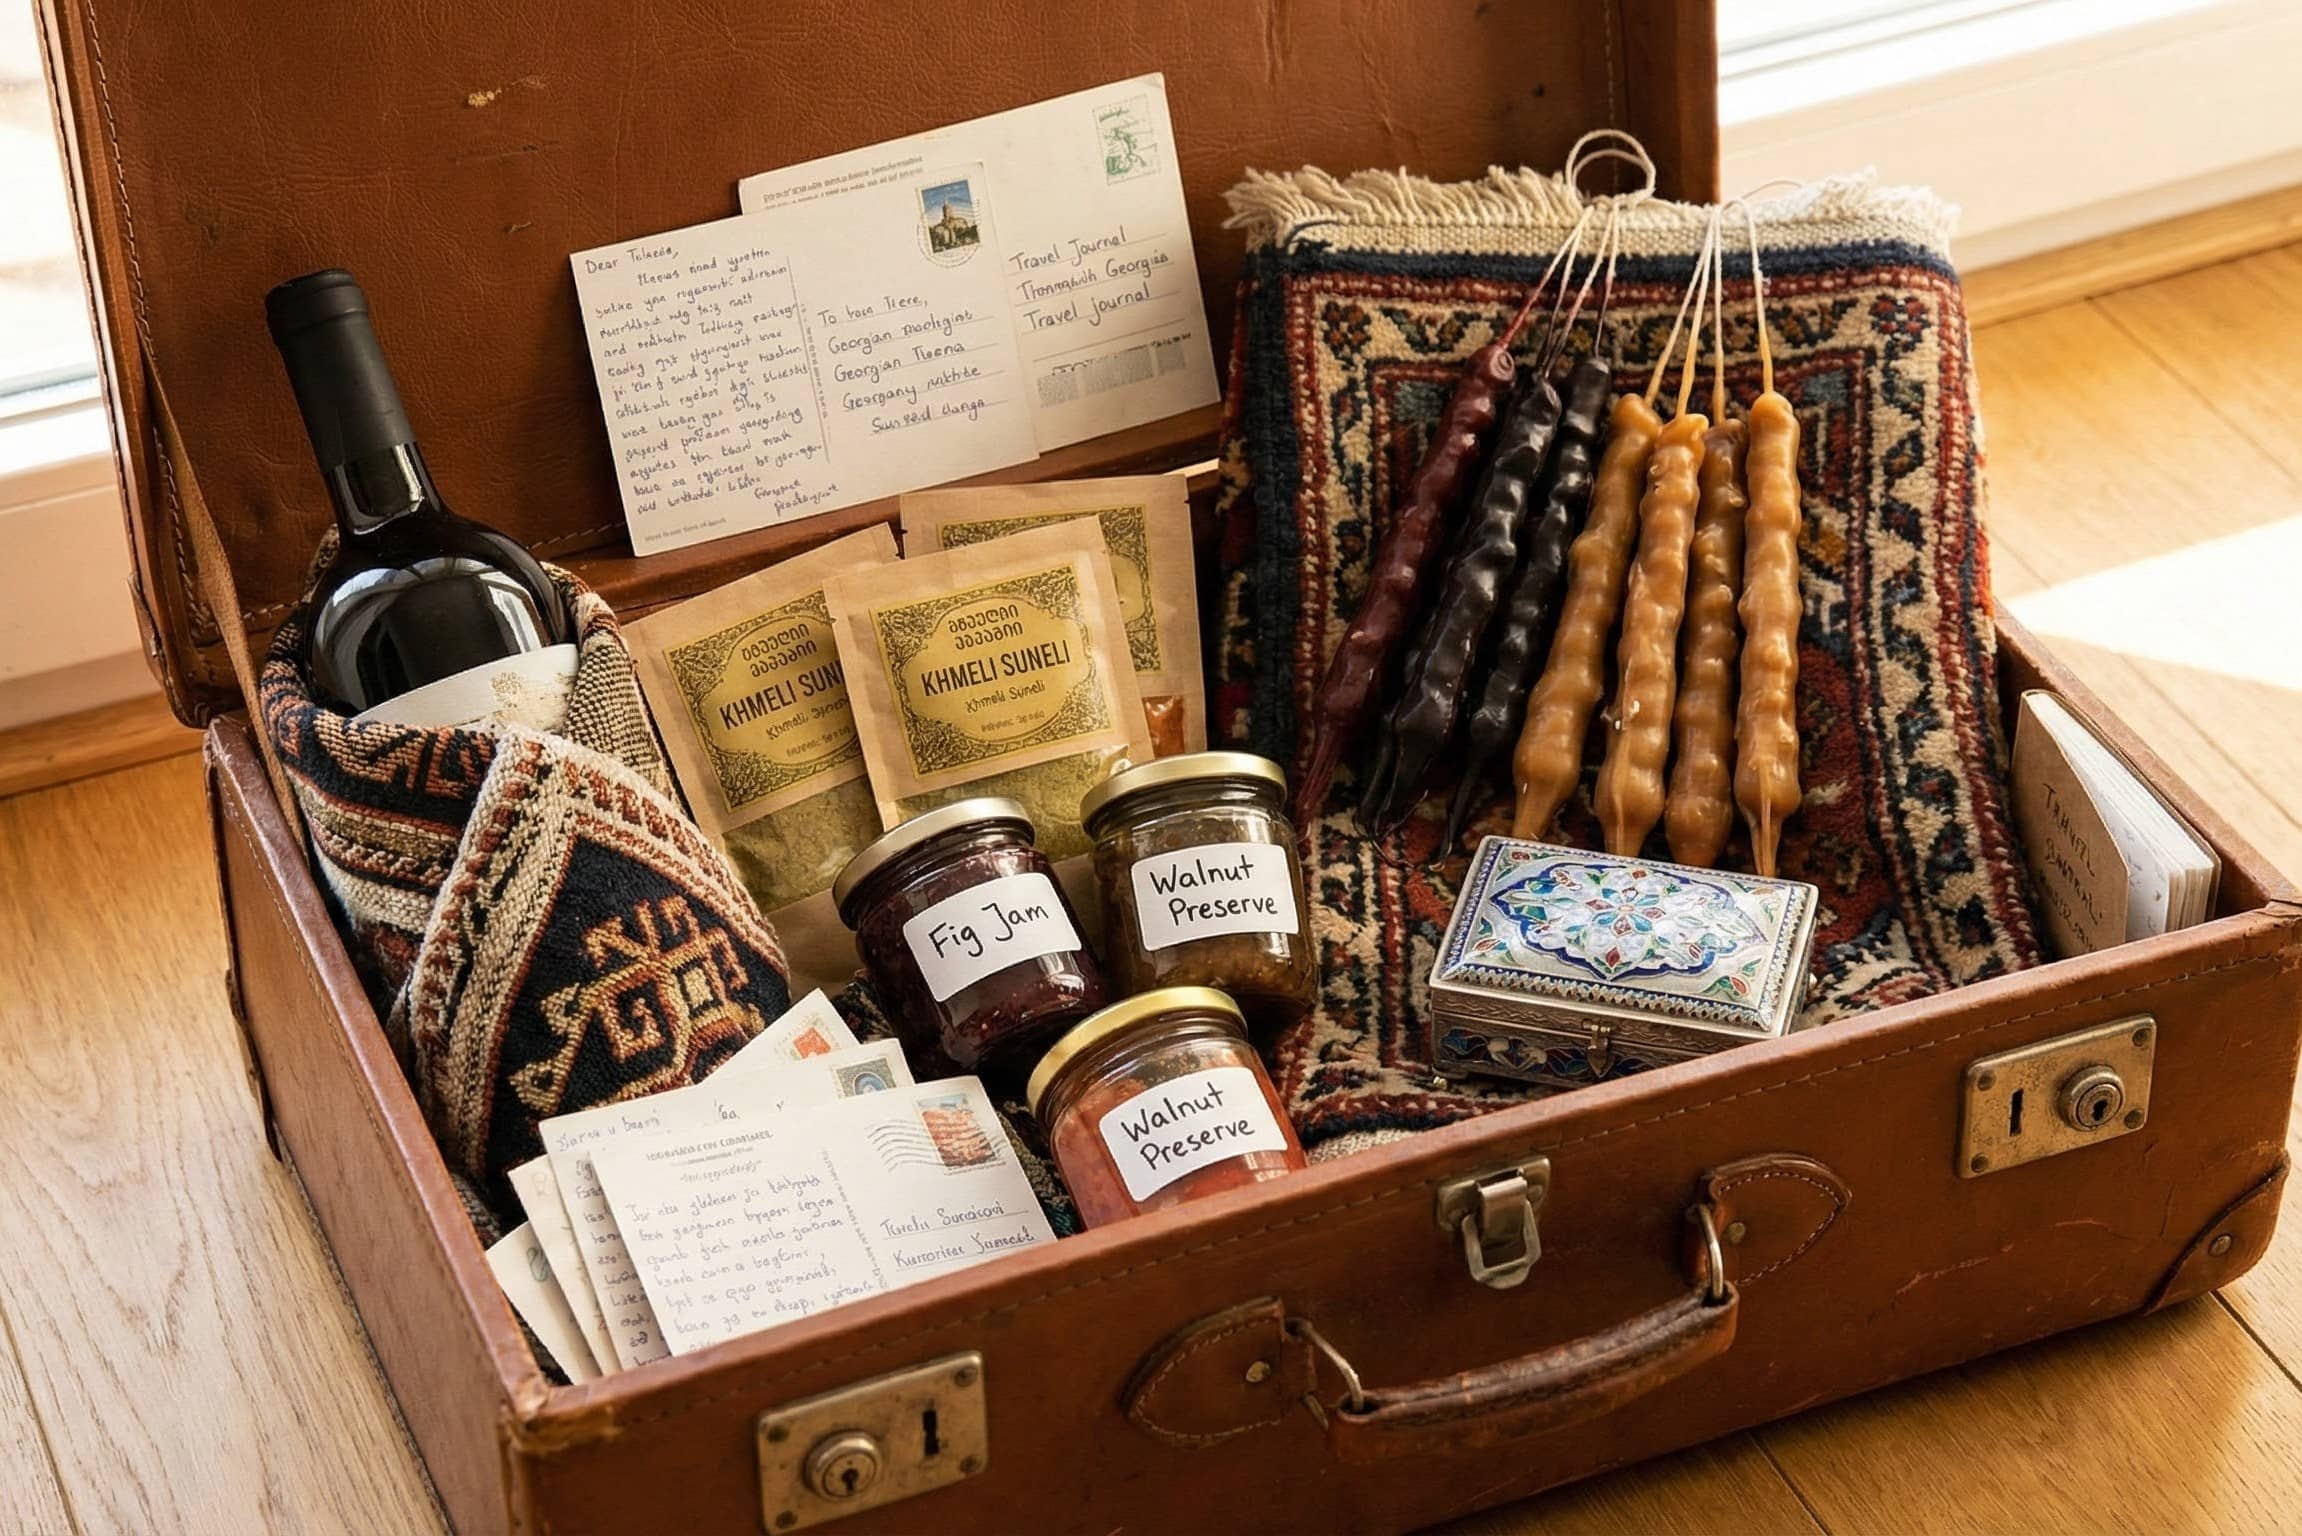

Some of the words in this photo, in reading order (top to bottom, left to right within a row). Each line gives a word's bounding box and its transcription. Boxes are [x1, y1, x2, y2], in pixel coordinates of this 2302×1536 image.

[586, 258, 618, 274] Dear
[1009, 244, 1060, 271] Travel
[1068, 225, 1127, 266] Journal
[818, 309, 837, 327] To
[1024, 302, 1078, 330] Travel
[834, 358, 901, 383] Georgian
[921, 657, 998, 696] KHMELI
[1000, 640, 1071, 676] SUNELI
[719, 680, 798, 730] KHMELI
[1150, 853, 1254, 896] Walnut
[927, 922, 984, 960] Fig
[981, 901, 1049, 942] Jam
[1168, 896, 1279, 927] Preserve
[1120, 1081, 1224, 1143] Walnut
[1139, 1116, 1255, 1171] Preserve
